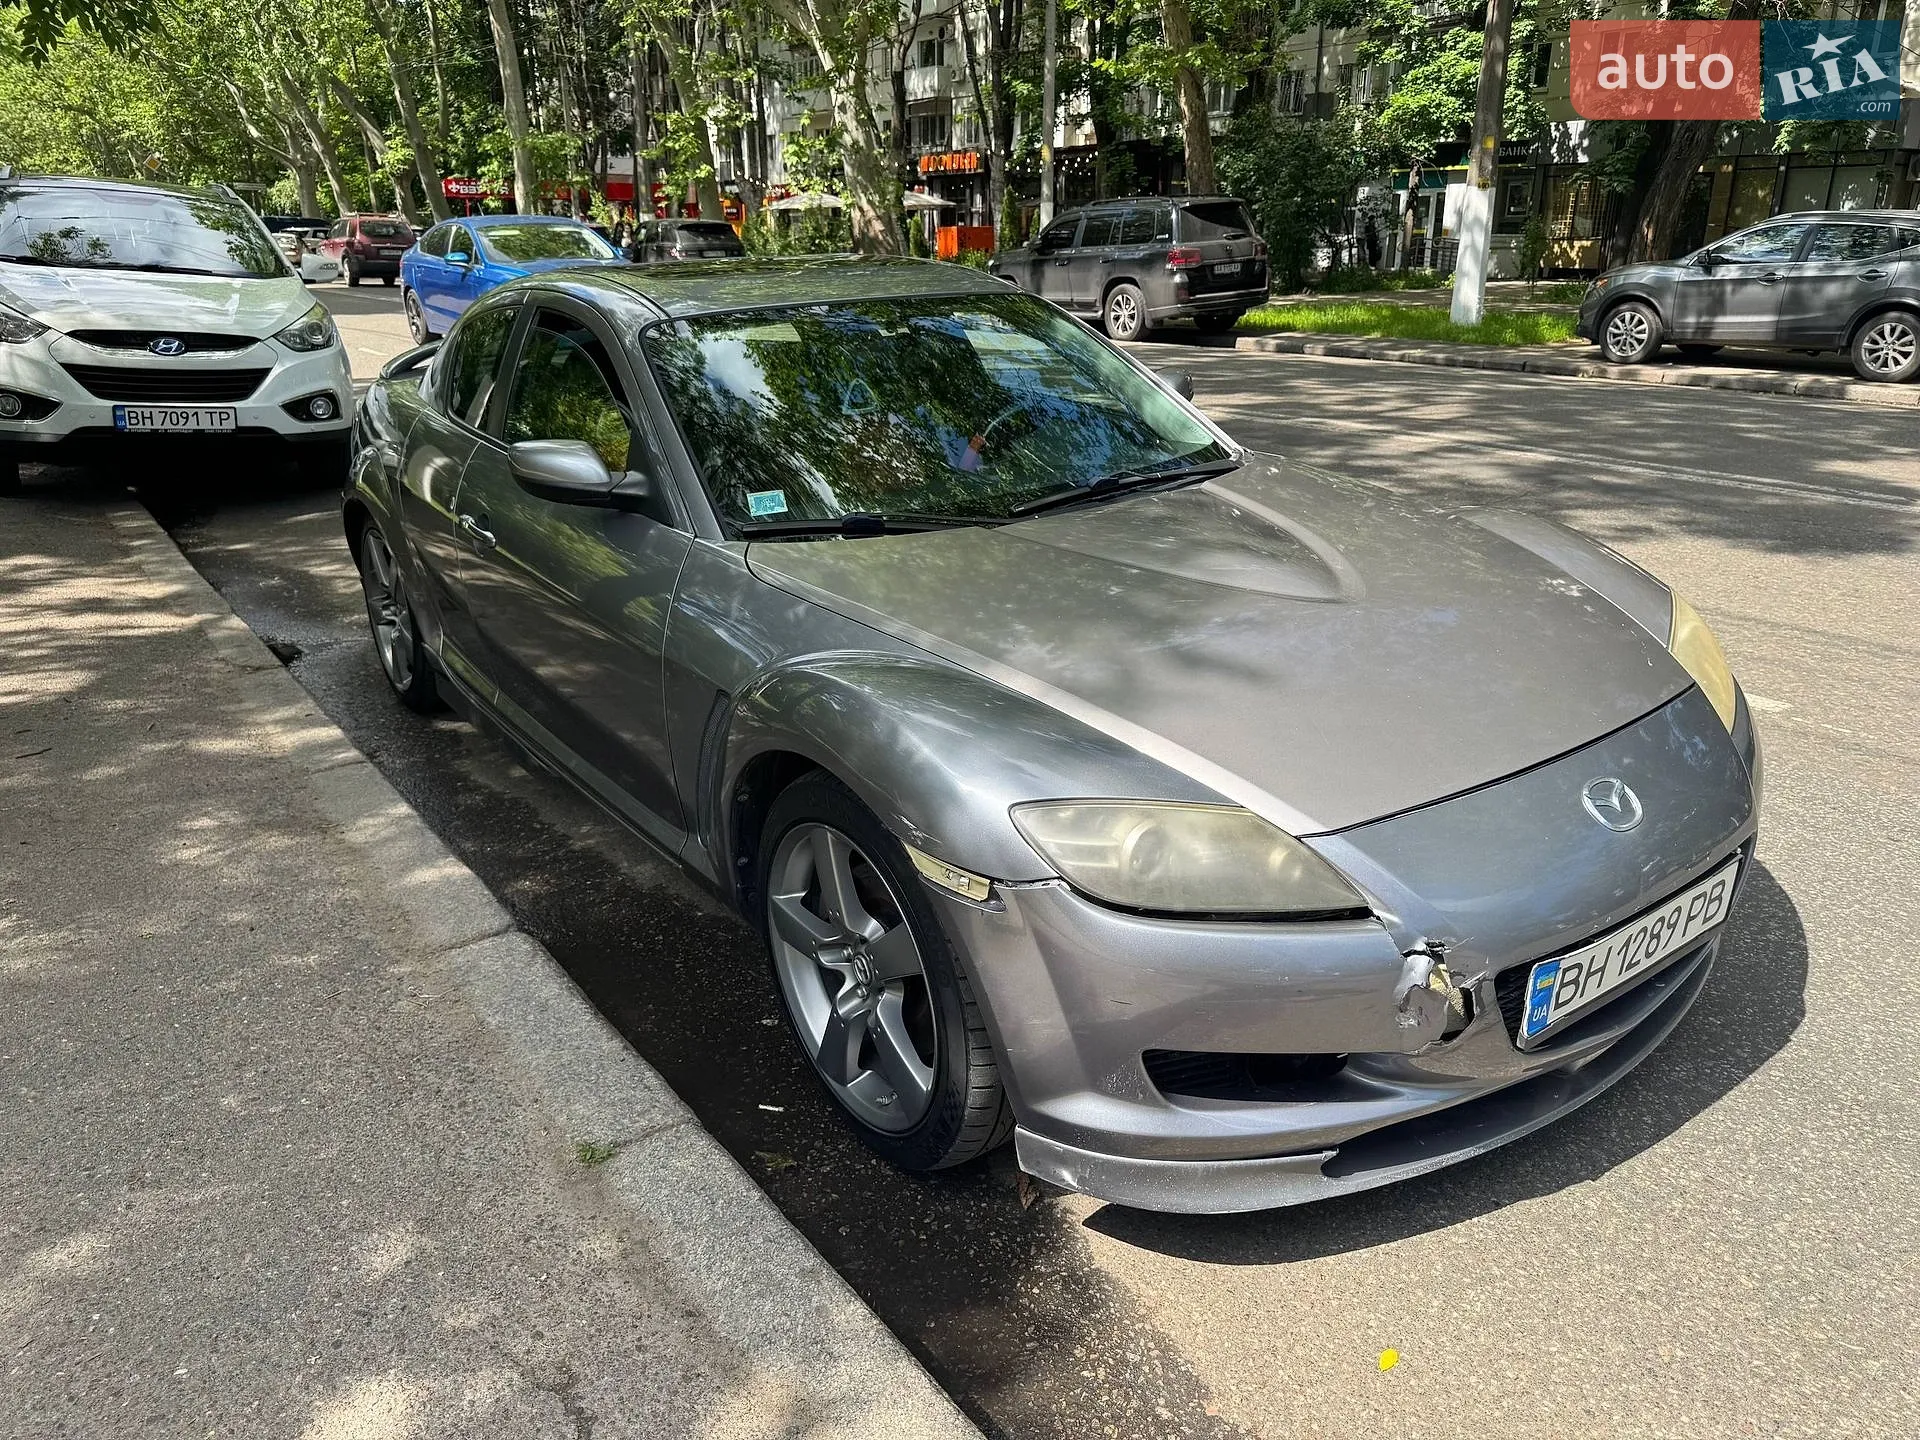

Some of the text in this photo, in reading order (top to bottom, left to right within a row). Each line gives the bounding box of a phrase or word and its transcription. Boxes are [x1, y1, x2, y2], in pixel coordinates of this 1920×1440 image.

[117, 419, 126, 427] UA
[127, 410, 231, 427] BH 7091 TP
[1553, 878, 1727, 1012] BH 1289 PB
[1532, 1006, 1548, 1022] UA
